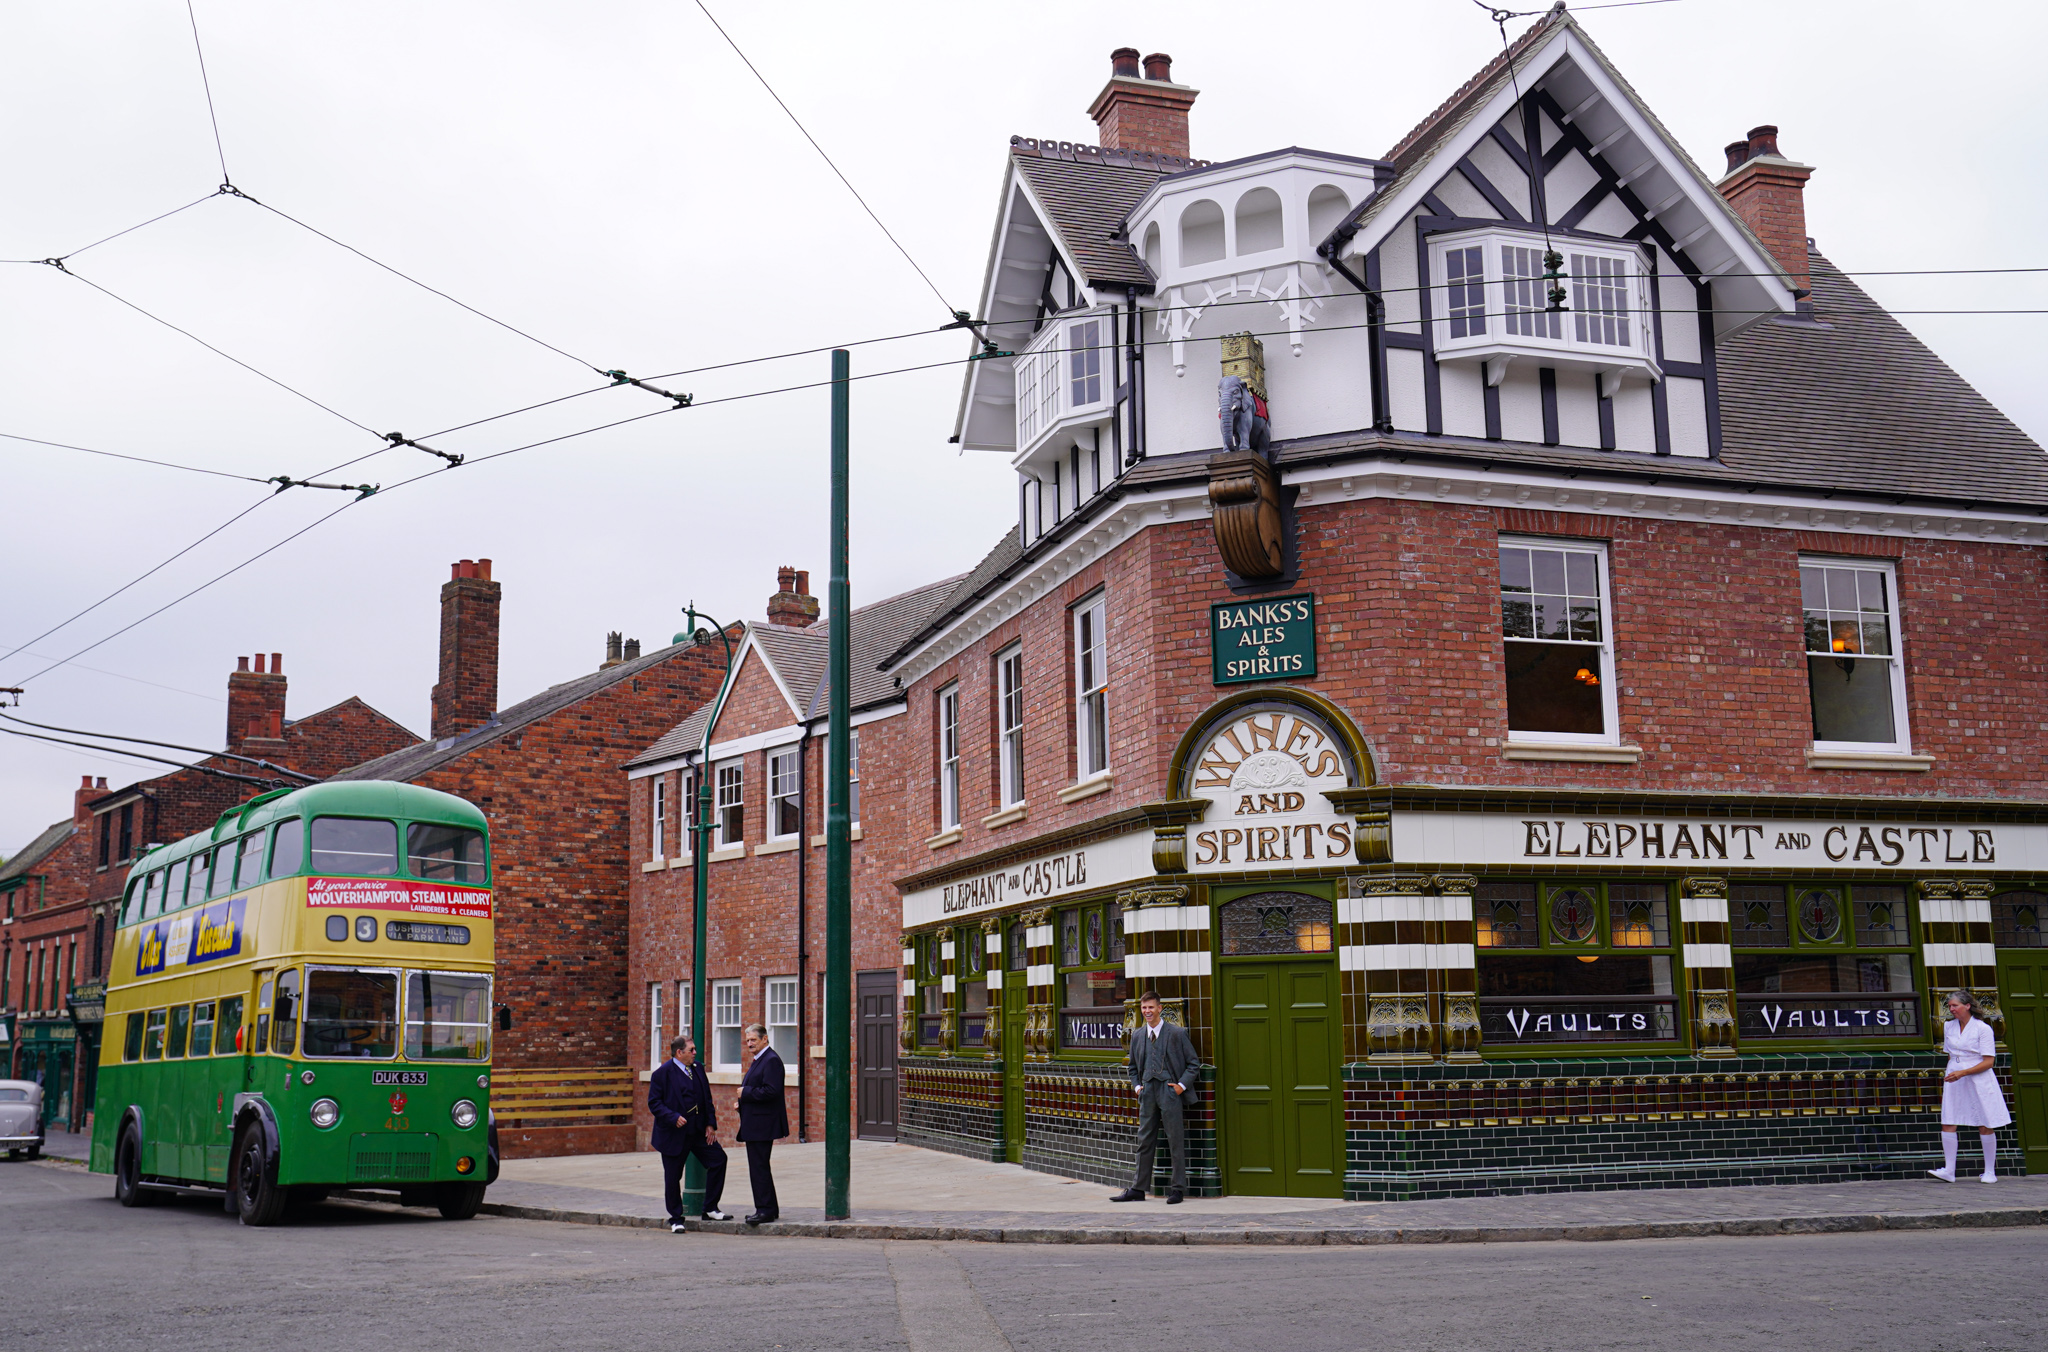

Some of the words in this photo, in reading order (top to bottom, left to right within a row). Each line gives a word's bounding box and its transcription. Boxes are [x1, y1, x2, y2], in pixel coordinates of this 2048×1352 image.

[1218, 600, 1309, 630] BANKS'S
[1237, 626, 1285, 647] ALES
[1258, 645, 1270, 656] &
[1226, 654, 1303, 677] SPIRITS
[1195, 714, 1344, 789] WINES
[1235, 791, 1305, 815] AND
[1195, 821, 1352, 865] SPIRITS
[1522, 820, 1764, 860] ELEPHANT
[1775, 832, 1811, 850] AND
[1823, 825, 1995, 866] CASTLE
[309, 878, 325, 891] At
[325, 881, 351, 892] your
[351, 881, 387, 890] service
[943, 872, 1006, 914] ELEPHANT
[1008, 874, 1020, 891] AND
[1023, 851, 1086, 896] CASTLE
[308, 891, 409, 905] WOLVERHAMPTON
[412, 891, 446, 904] STEAM
[447, 892, 491, 906] LAUNDRY
[410, 904, 449, 914] LAUNDERERS
[459, 908, 489, 918] CLEANERS
[357, 919, 372, 939] 3
[387, 924, 440, 935] BUSHBURY
[444, 927, 465, 936] HILL
[407, 933, 434, 942] PARK
[438, 935, 465, 944] LANE
[1506, 1008, 1647, 1039] VAULTS
[1760, 1004, 1891, 1034] VAULTS
[375, 1072, 399, 1083] DUK
[402, 1073, 425, 1083] 833
[384, 1117, 410, 1131] 433
